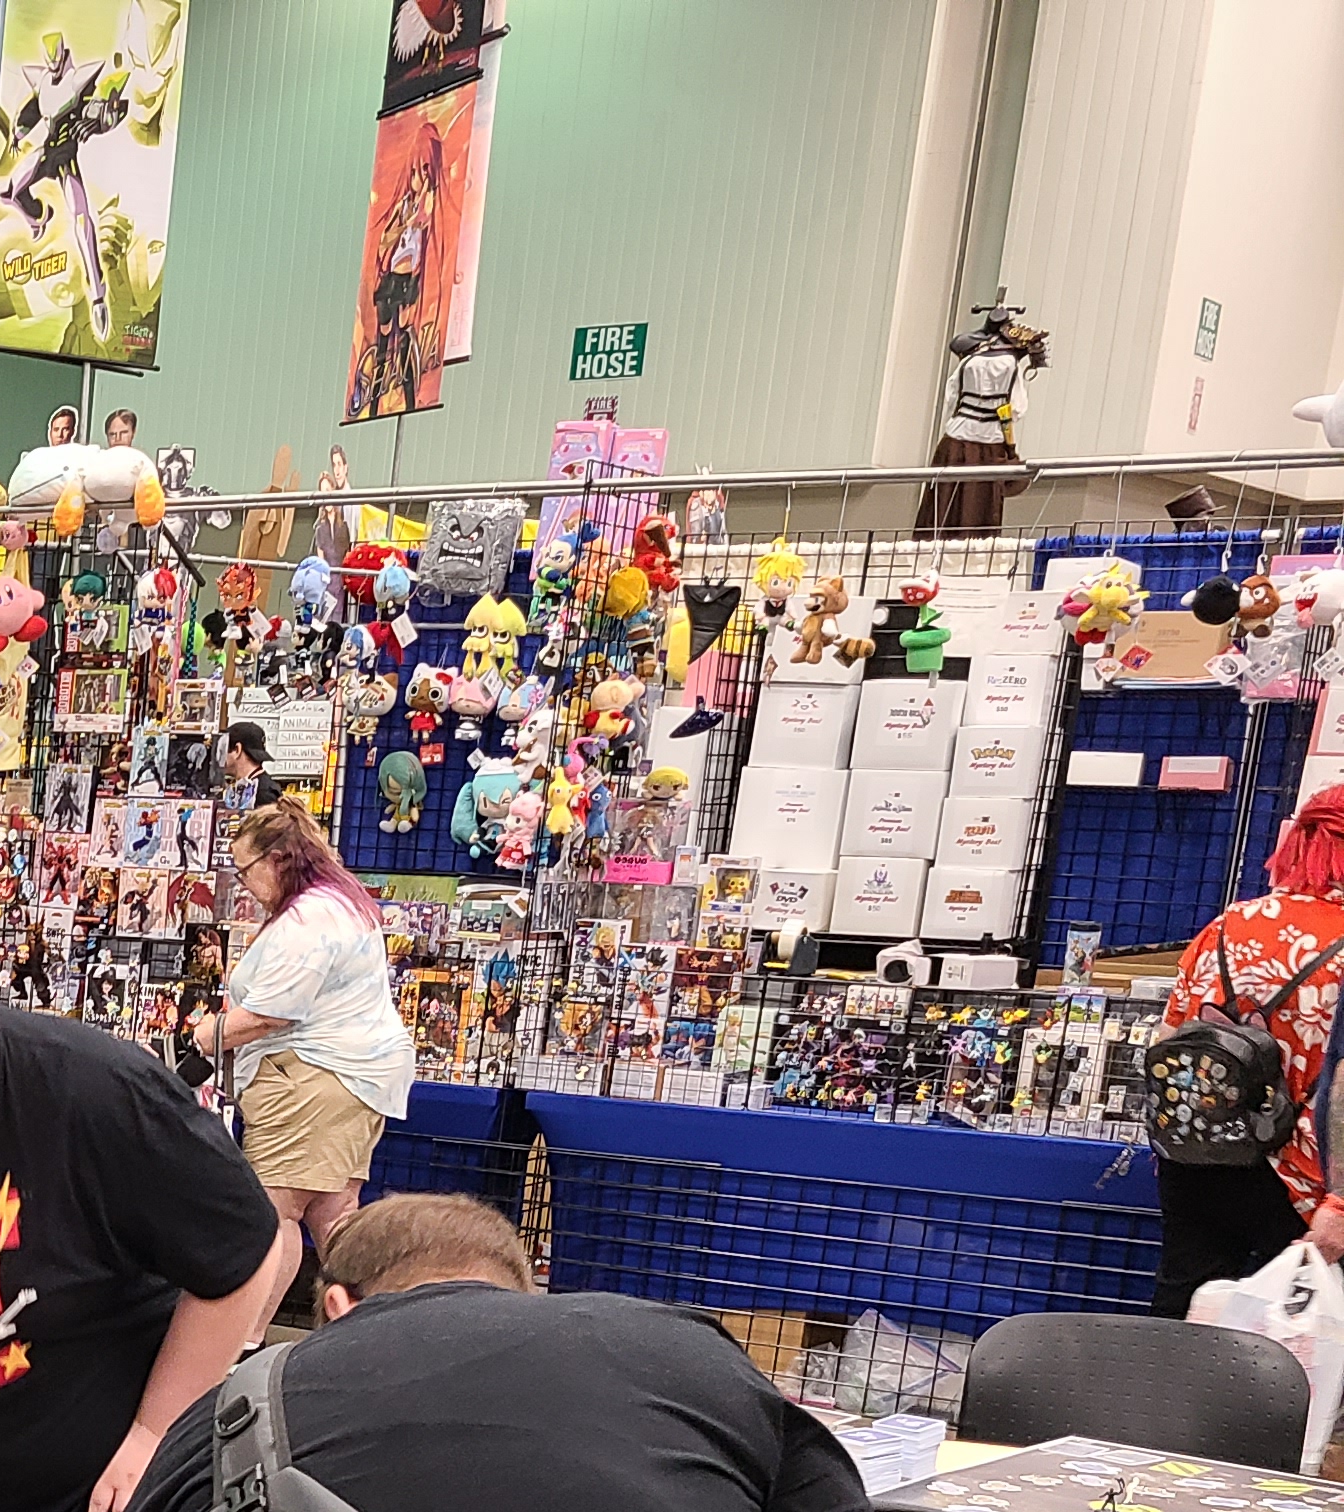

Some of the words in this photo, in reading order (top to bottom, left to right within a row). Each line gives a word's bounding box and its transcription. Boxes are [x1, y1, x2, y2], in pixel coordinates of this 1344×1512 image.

[2, 252, 32, 281] WILD
[32, 251, 68, 281] TIGER
[585, 326, 636, 352] FIRE
[575, 351, 638, 378] HOSE
[591, 401, 612, 409] FIRE
[776, 895, 798, 903] DVD
